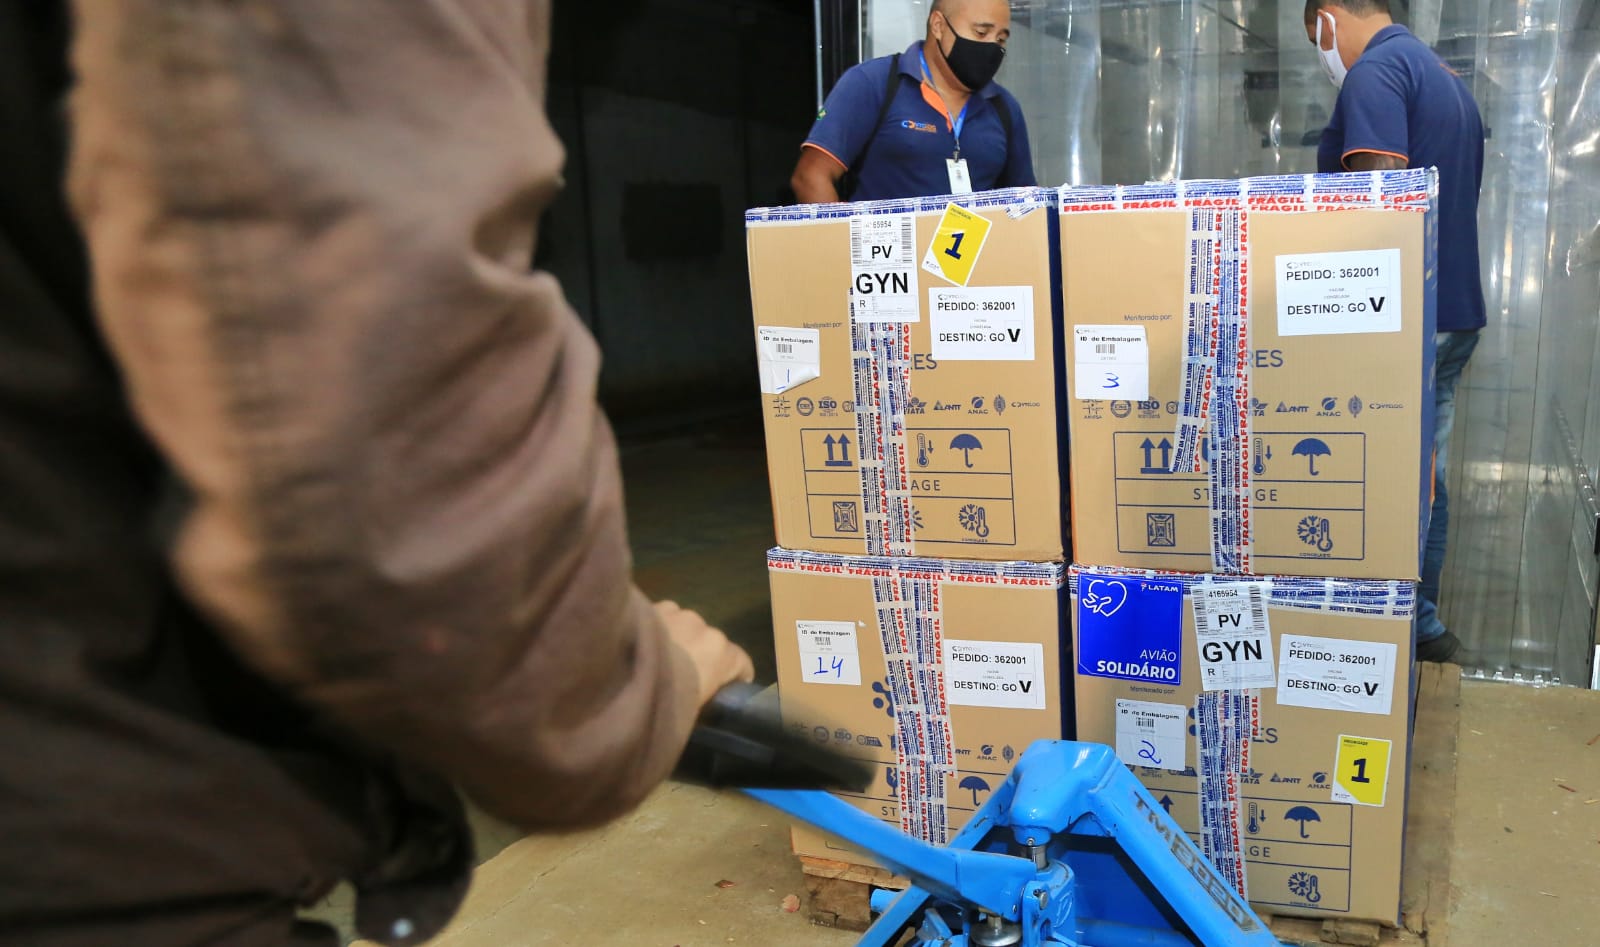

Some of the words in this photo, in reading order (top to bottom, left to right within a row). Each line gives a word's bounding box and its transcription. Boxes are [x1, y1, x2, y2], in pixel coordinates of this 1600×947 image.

[872, 246, 892, 259] PV
[944, 232, 965, 260] 1
[1286, 270, 1336, 281] PEDIDO:
[1340, 267, 1380, 278] 362001
[856, 272, 909, 294] GYN
[860, 300, 866, 308] R
[938, 302, 979, 311] PEDIDO:
[982, 302, 1016, 311] 362001
[1288, 304, 1344, 315] DESTINO:
[1348, 302, 1366, 312] GO
[1370, 296, 1385, 312] V
[940, 333, 986, 342] DESTINO:
[990, 333, 1006, 342] GO
[1008, 329, 1021, 342] V
[1102, 372, 1120, 388] 3
[1137, 401, 1160, 410] ISO
[1148, 584, 1179, 593] LATAM
[1218, 614, 1242, 628] PV
[1140, 649, 1177, 662] AVIÃO
[1203, 640, 1262, 663] GYN
[1289, 650, 1336, 662] PEDIDO:
[1339, 654, 1376, 666] 362001
[952, 653, 992, 663] PEDIDO:
[995, 656, 1026, 664] 362001
[814, 656, 844, 678] 14
[1097, 660, 1176, 680] SOLIDÁRIO
[1208, 668, 1216, 676] R
[954, 681, 1000, 691] DESTINO:
[1002, 683, 1017, 692] GO
[1019, 680, 1032, 693] V
[1287, 679, 1340, 692] DESTINO:
[1344, 685, 1361, 694] GO
[1364, 682, 1378, 696] V
[1142, 712, 1180, 720] Embalagem
[1138, 740, 1162, 764] 2
[1351, 758, 1370, 784] 1
